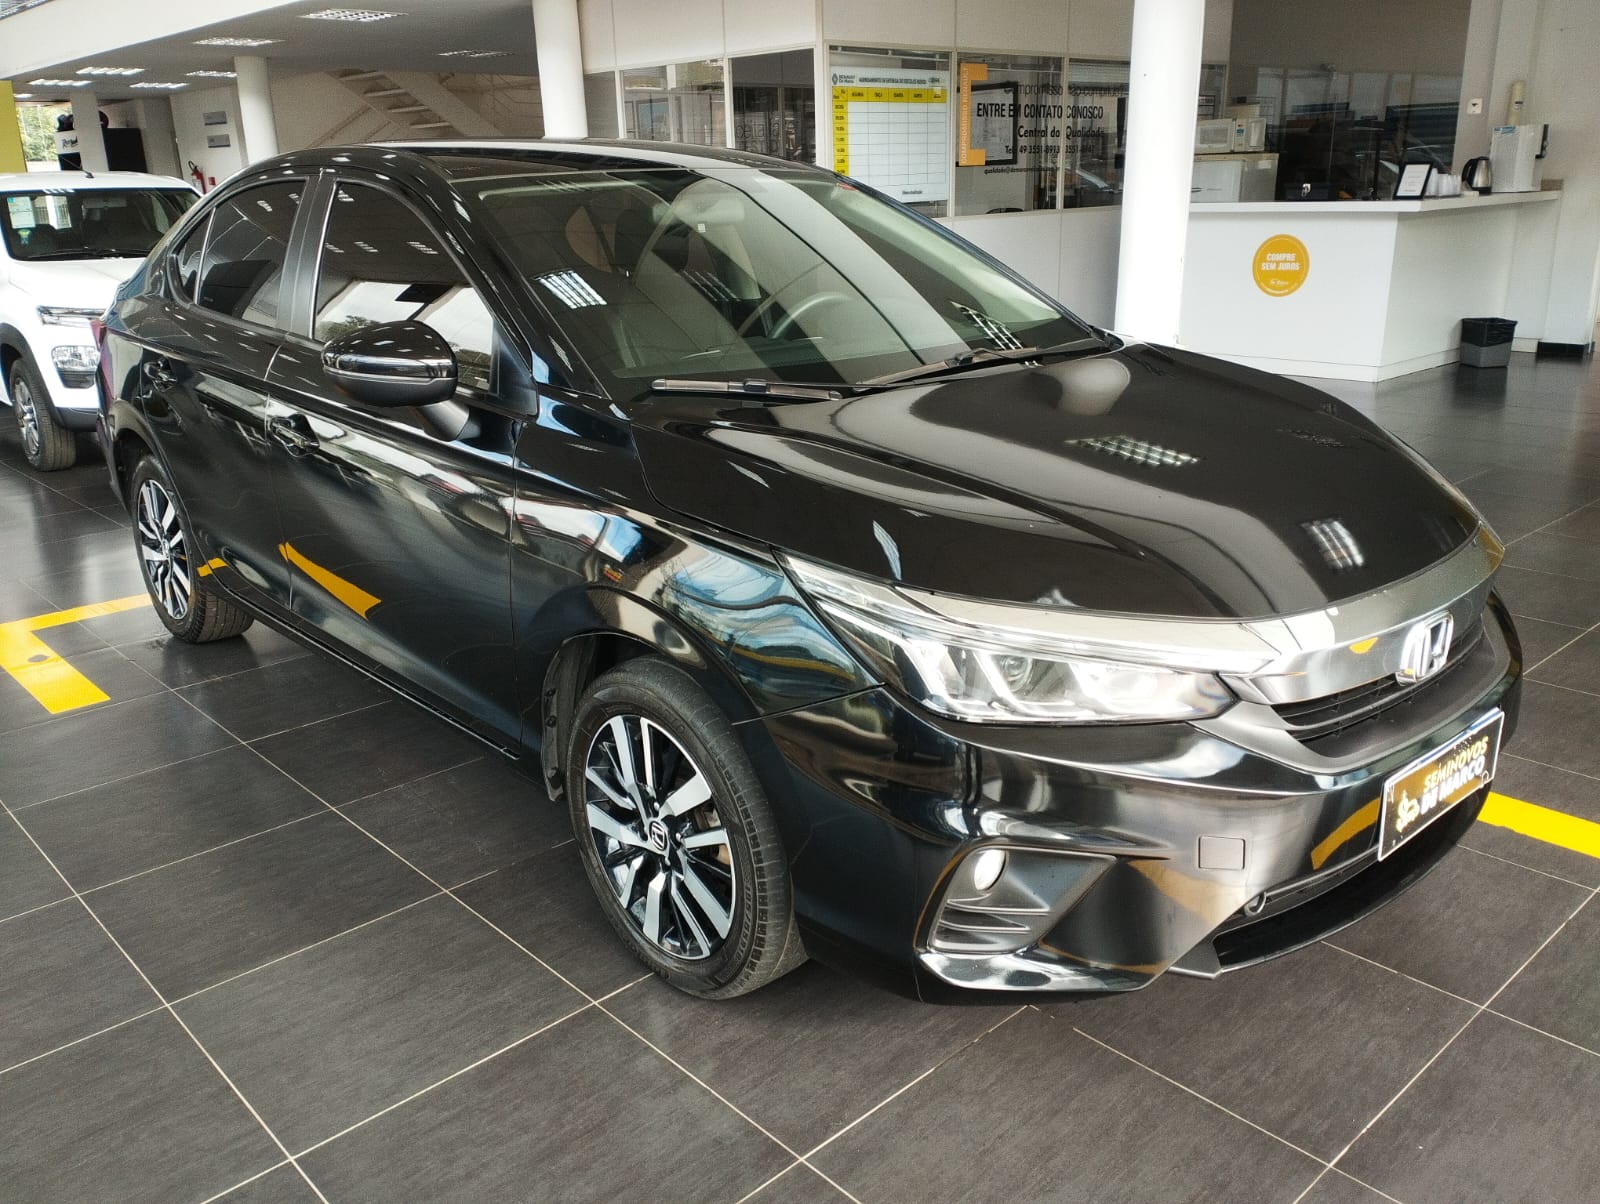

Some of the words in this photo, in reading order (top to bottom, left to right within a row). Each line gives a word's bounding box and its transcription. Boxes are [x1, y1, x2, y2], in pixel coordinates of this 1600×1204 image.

[977, 103, 1006, 118] ENTRE
[1024, 103, 1063, 119] CONTATO
[1066, 105, 1104, 119] CONOSCO
[1017, 125, 1048, 138] Central
[1066, 125, 1105, 140] Qualidade
[1266, 253, 1297, 262] COMPRE
[1261, 262, 1276, 271] SEM
[1277, 262, 1300, 271] JUROS
[1423, 735, 1489, 794] SEMINOVOS
[1420, 785, 1439, 815] DE
[1438, 755, 1486, 801] MARCO
